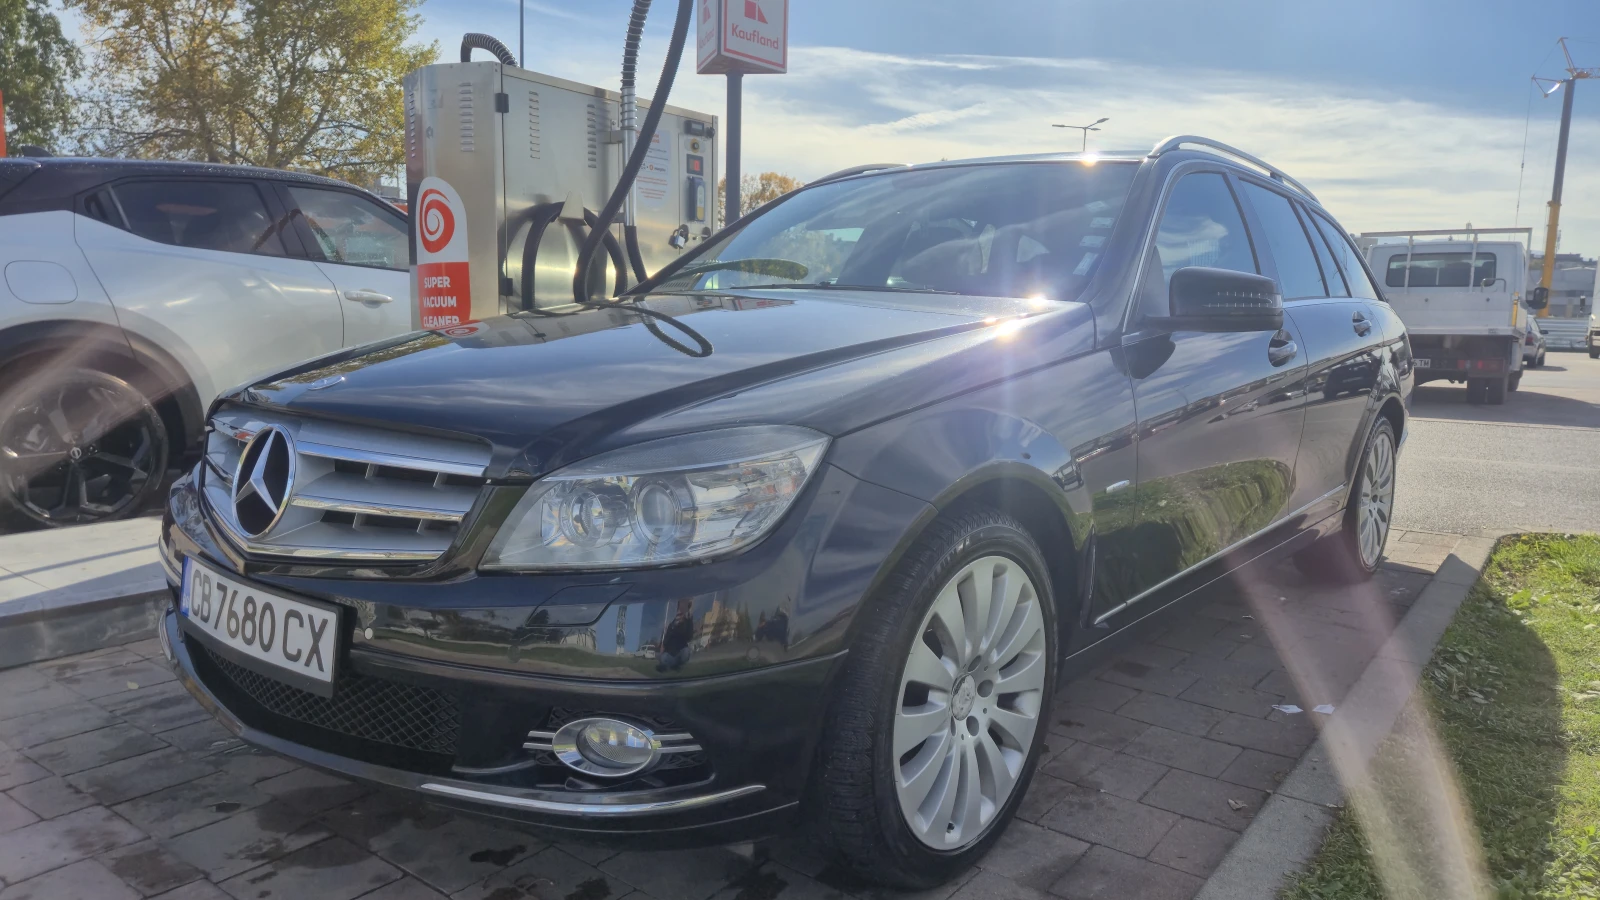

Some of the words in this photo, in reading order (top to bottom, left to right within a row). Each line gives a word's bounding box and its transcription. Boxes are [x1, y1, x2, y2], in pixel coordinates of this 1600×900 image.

[731, 23, 779, 50] Kaufland
[423, 276, 451, 288] SUPER
[423, 296, 457, 308] VACUUM
[423, 315, 460, 328] CLEANER
